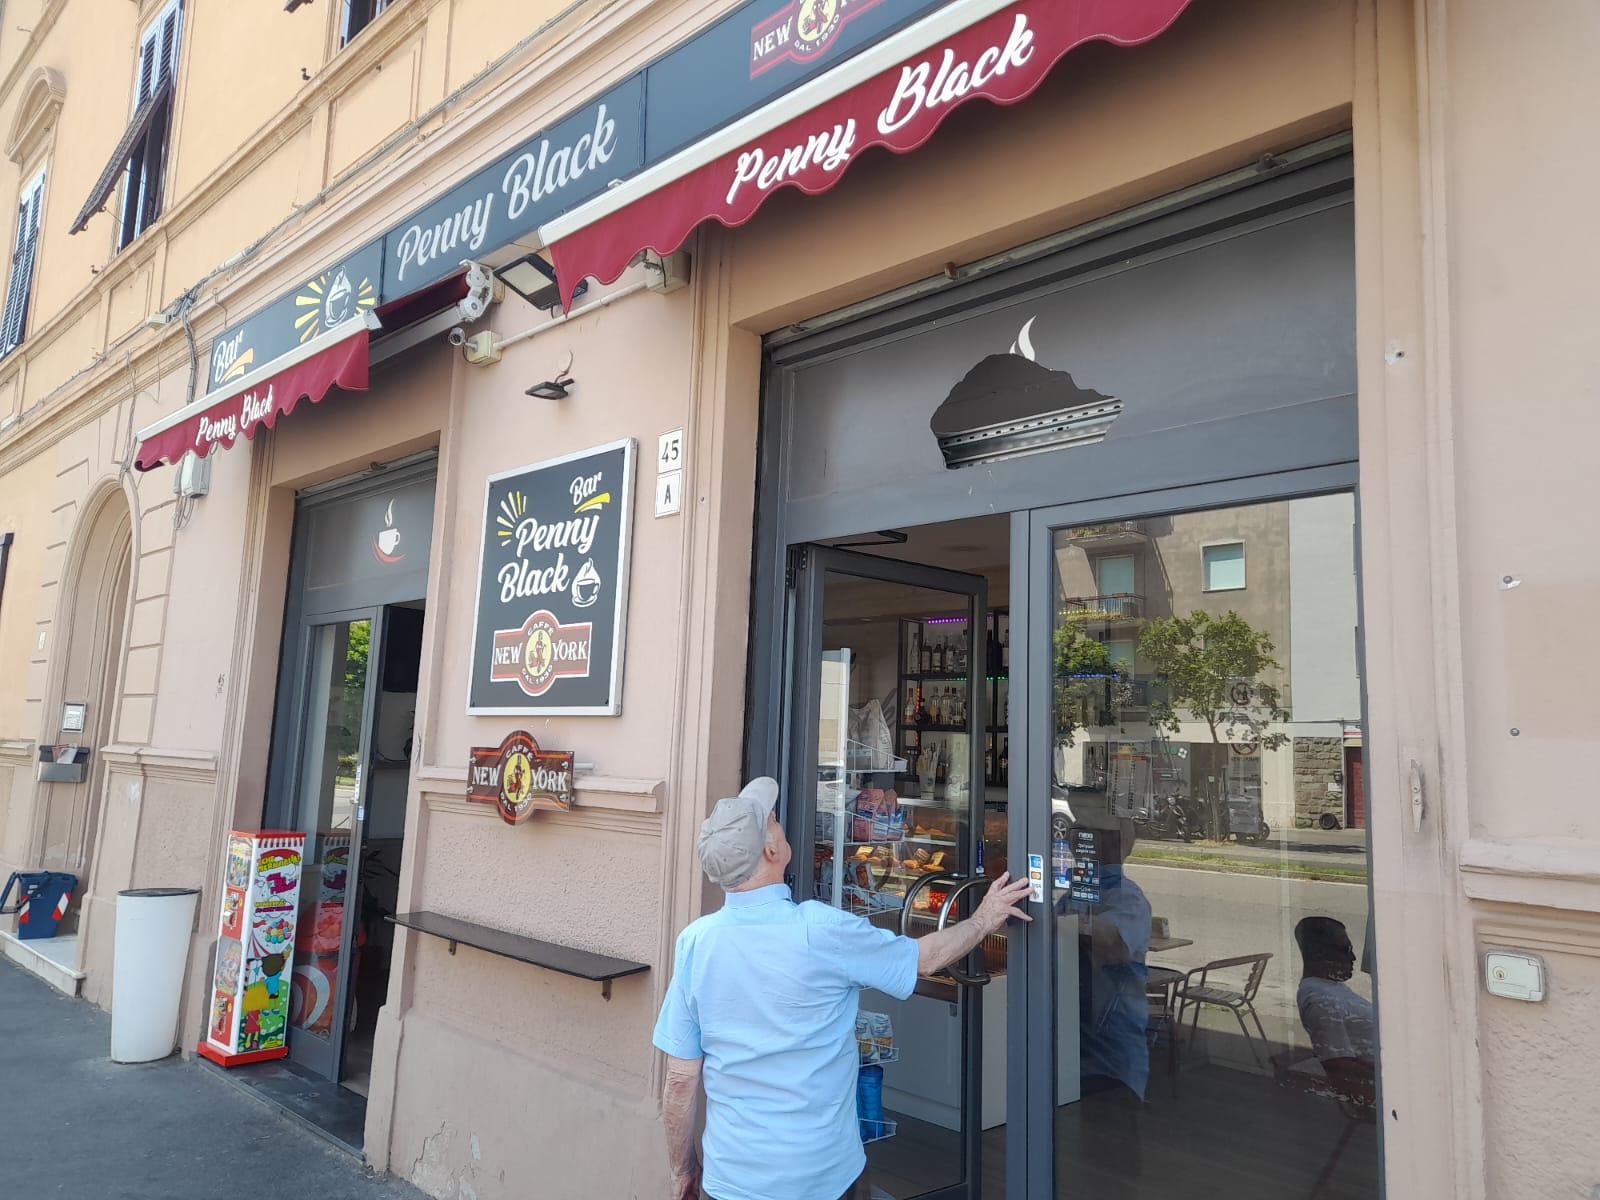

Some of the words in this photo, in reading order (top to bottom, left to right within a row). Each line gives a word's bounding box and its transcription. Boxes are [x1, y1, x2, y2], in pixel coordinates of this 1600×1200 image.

[753, 15, 793, 60] NEW
[726, 118, 856, 204] Penny
[877, 13, 1034, 134] Black
[396, 192, 495, 281] Penny
[502, 103, 618, 220] Black
[213, 329, 244, 383] Bar
[195, 413, 237, 446] Penny
[240, 383, 273, 430] Black
[661, 438, 680, 463] 45
[569, 471, 603, 506] Bar
[664, 484, 672, 505] A
[515, 514, 600, 558] Penny
[497, 552, 570, 603] Black
[494, 641, 523, 665] NEW
[551, 639, 589, 662] YORK
[472, 764, 502, 787] NEW
[531, 766, 569, 792] YORK
